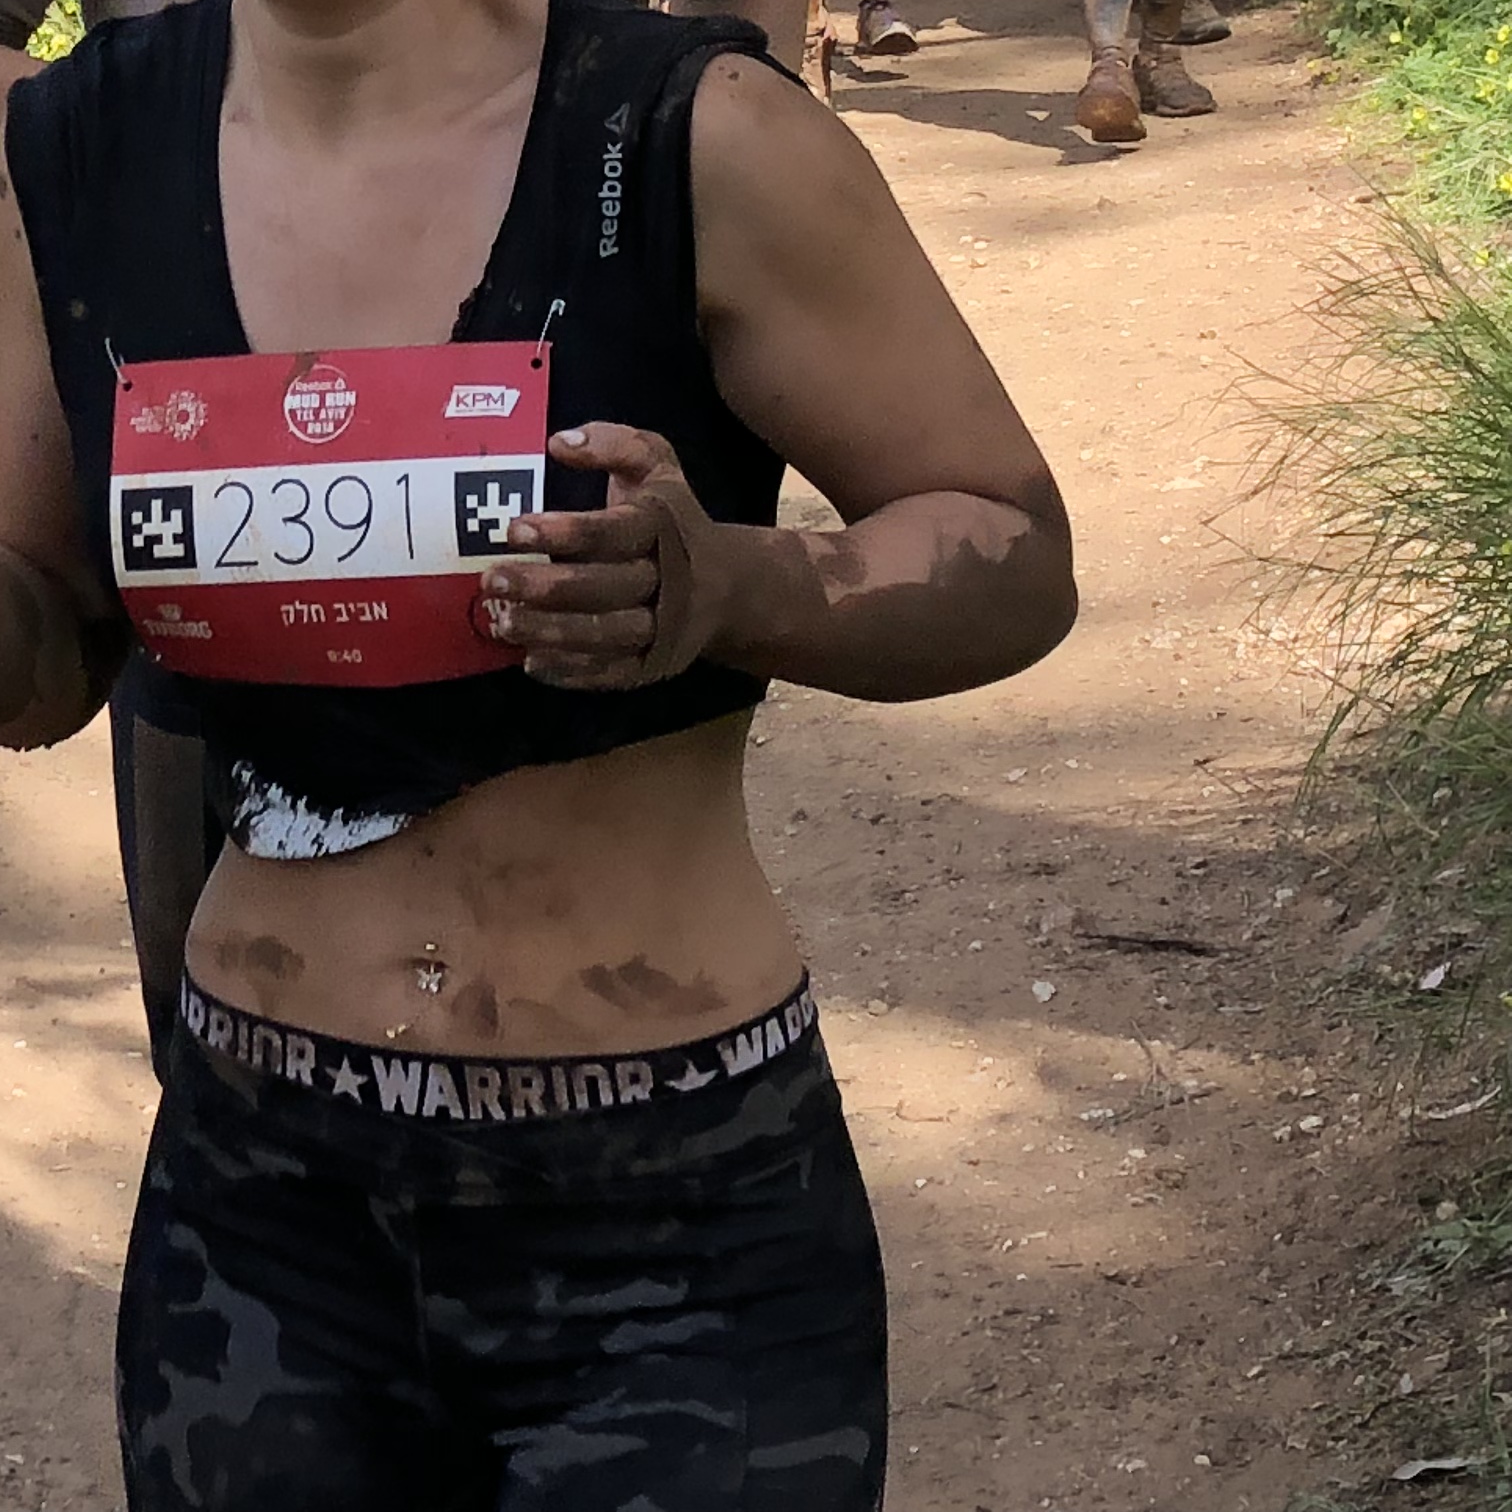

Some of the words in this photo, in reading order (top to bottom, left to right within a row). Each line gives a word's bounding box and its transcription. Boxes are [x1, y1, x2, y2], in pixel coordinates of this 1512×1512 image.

[598, 141, 624, 258] Reebok
[455, 391, 505, 408] KPM
[213, 472, 415, 568] 2391
[280, 599, 326, 627] חלק
[333, 601, 389, 623] אביב
[180, 975, 316, 1087] RRIOR
[370, 1054, 655, 1121] WARRIOR
